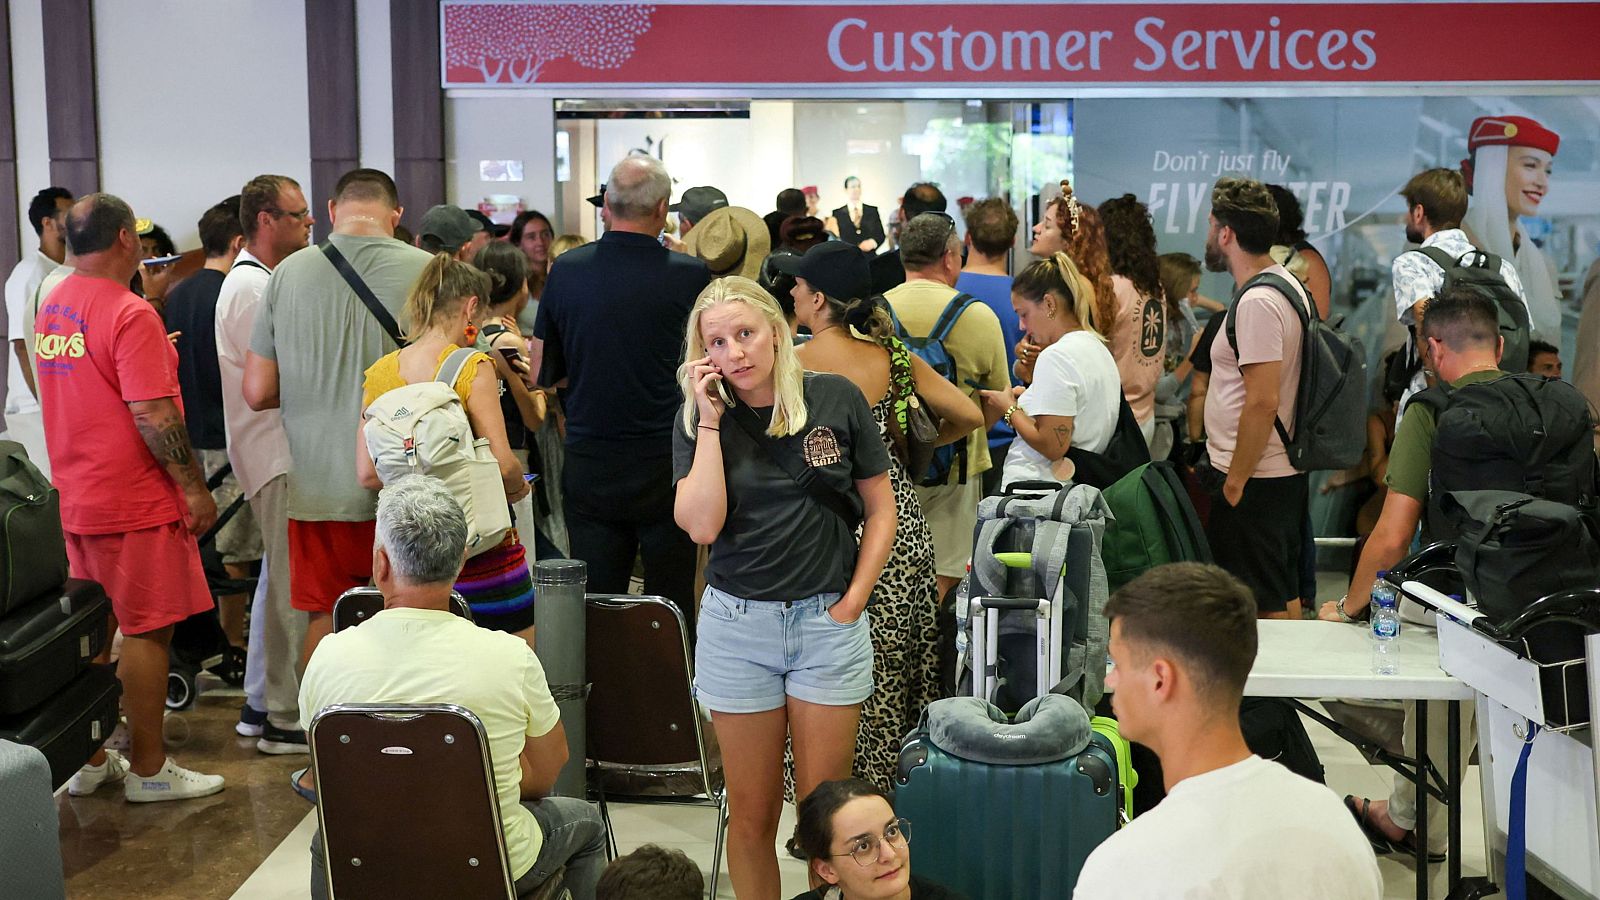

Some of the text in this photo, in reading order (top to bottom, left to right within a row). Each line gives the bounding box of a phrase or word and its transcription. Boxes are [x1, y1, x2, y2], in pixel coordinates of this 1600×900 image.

[827, 16, 1377, 72] Customer Services
[1153, 150, 1291, 177] Don't just fly
[1148, 182, 1207, 234] FLY
